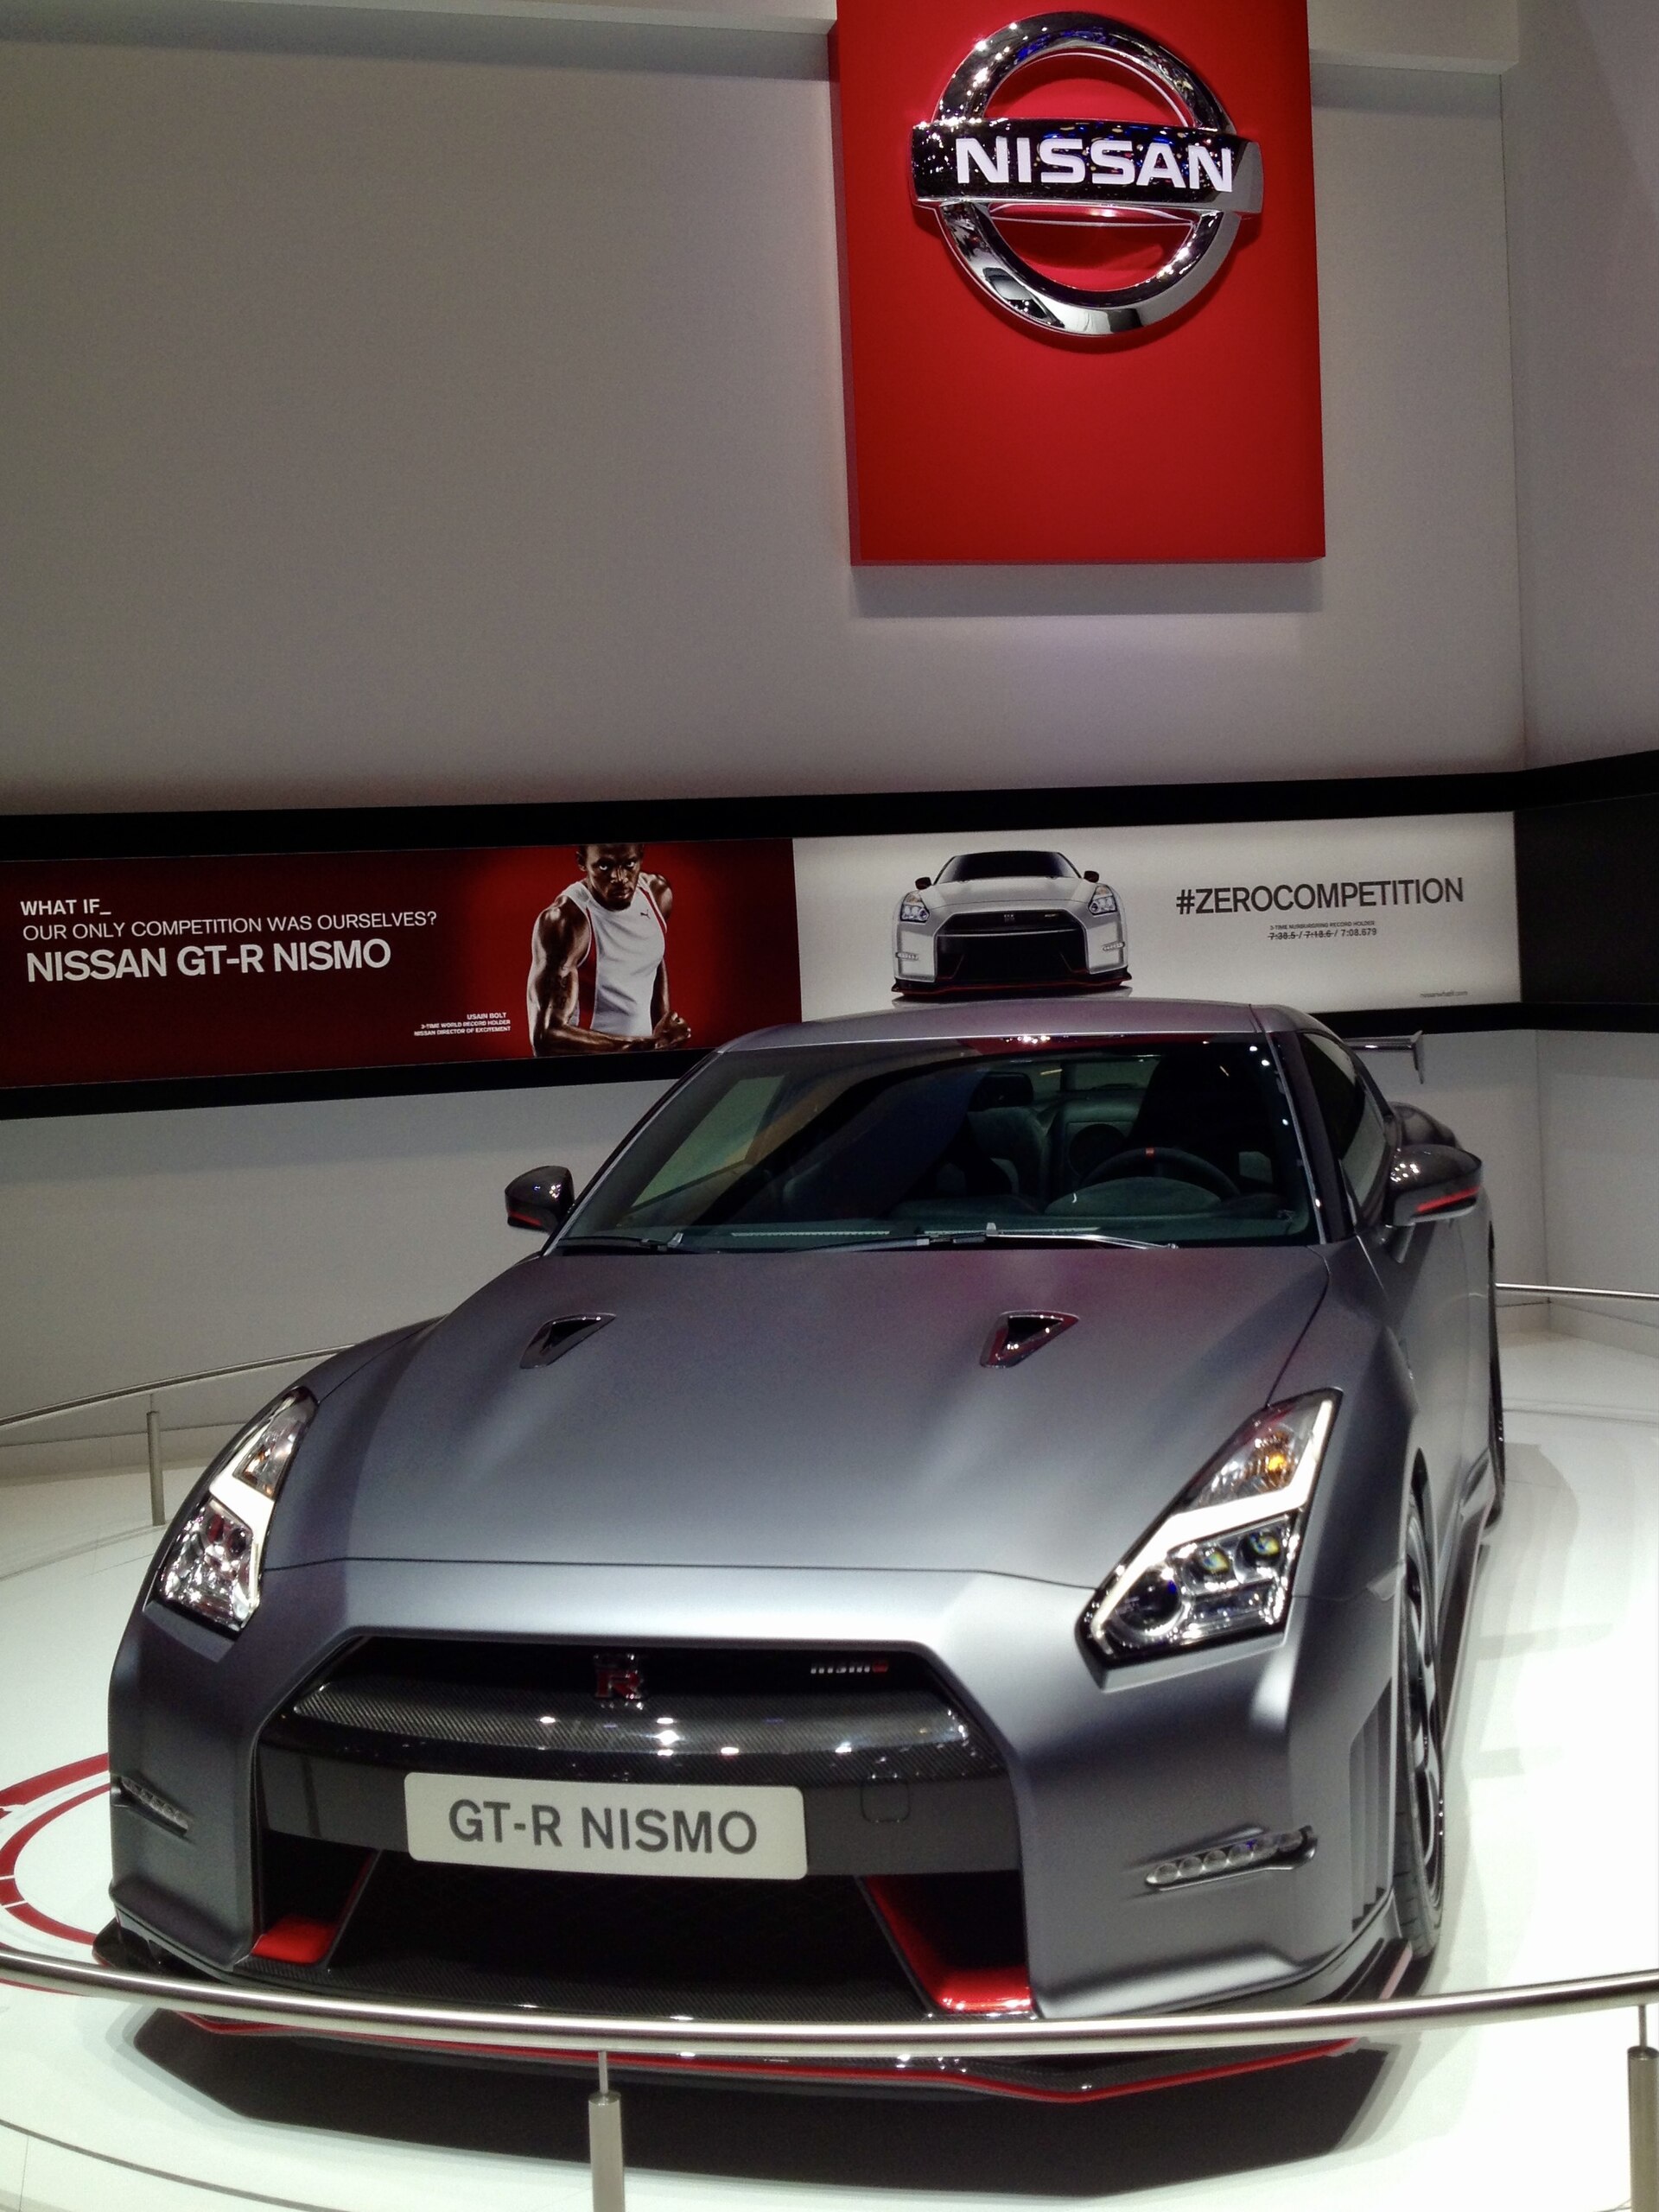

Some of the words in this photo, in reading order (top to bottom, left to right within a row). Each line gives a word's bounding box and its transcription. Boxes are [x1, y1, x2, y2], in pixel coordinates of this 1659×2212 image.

[956, 137, 1232, 192] NISSAN
[20, 899, 78, 916] WHAT
[1175, 876, 1465, 915] #ZEROCOMPETITION
[22, 924, 67, 941] OUR
[72, 922, 125, 939] ONLY
[130, 917, 262, 938] COMPETITION
[266, 915, 313, 932] WAS
[317, 911, 437, 931] OURSELVES?
[26, 947, 168, 982] NISSAN
[176, 944, 265, 976] GT-R
[273, 938, 391, 972] NISMO
[448, 1799, 563, 1847] GT-R
[581, 1807, 757, 1854] NISMO
